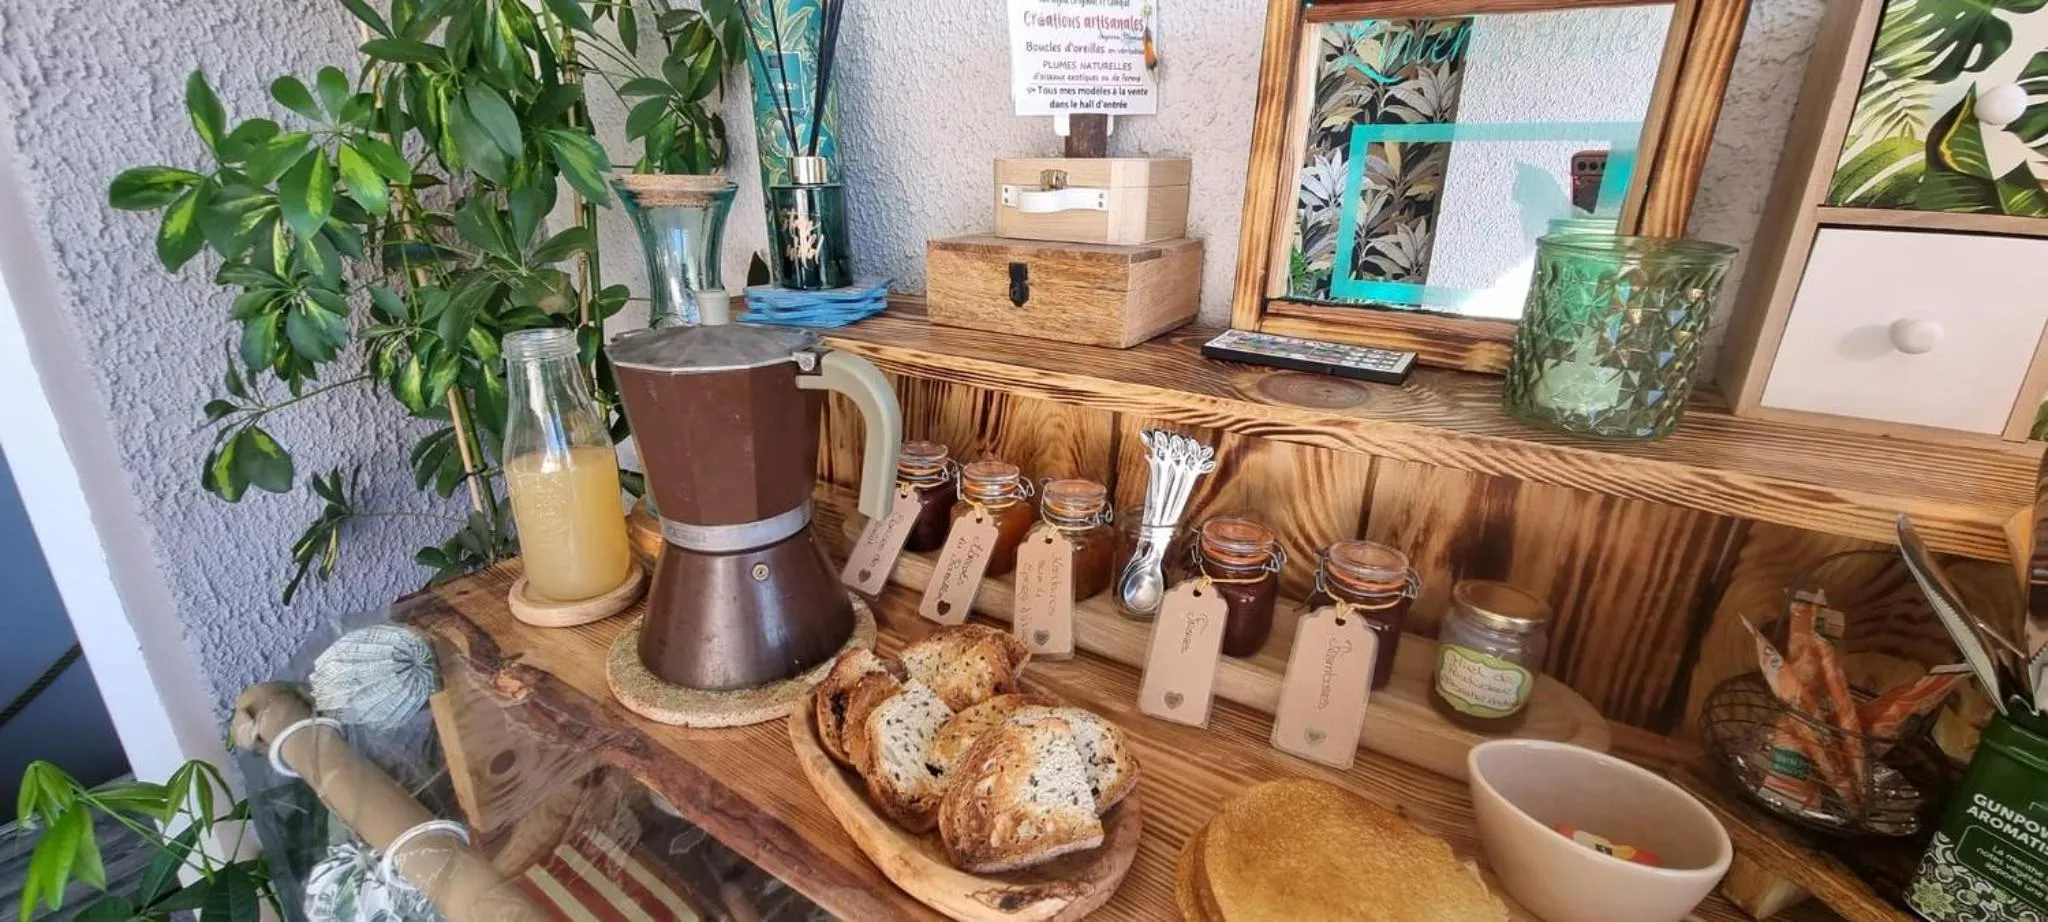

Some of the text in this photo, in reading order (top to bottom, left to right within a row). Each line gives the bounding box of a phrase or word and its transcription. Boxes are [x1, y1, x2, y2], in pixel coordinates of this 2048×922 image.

[1023, 11, 1144, 32] Créations artisanales
[1026, 42, 1061, 53] Boucles
[1064, 42, 1105, 54] d'oreilles
[1043, 61, 1132, 71] PLUMES NATURELLES
[1033, 72, 1065, 81] d'oiseaux
[1067, 73, 1099, 83] exotiques
[1112, 74, 1120, 82] de
[1038, 86, 1058, 95] Tous
[1059, 88, 1076, 96] mes
[1078, 86, 1111, 96] modèles
[1119, 86, 1126, 96] la
[1128, 88, 1148, 96] vente
[1049, 100, 1128, 109] dans le hall d'entrée
[1976, 847, 2004, 866] notes
[1992, 845, 2044, 878] La menthe
[1985, 862, 2044, 898] apporte une
